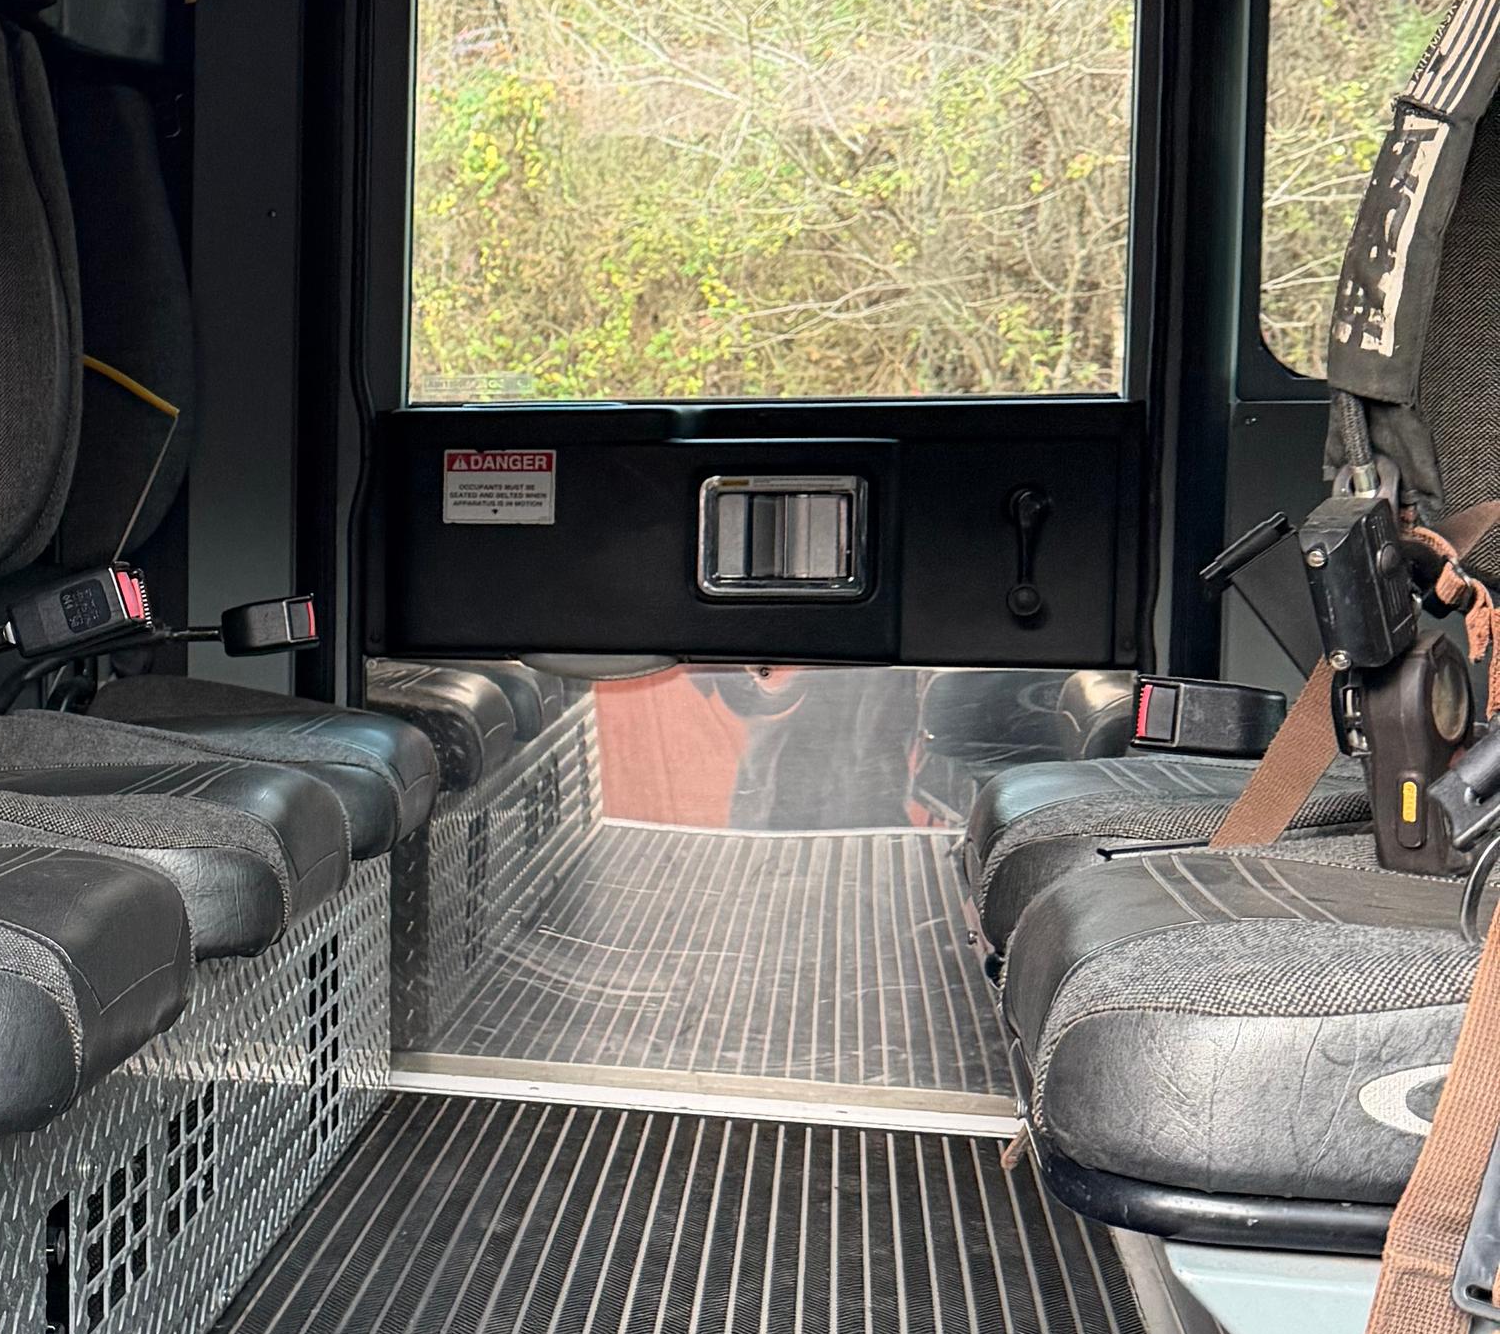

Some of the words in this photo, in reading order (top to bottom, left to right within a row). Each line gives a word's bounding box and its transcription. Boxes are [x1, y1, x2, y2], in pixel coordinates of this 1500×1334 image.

[469, 454, 548, 471] DANGER
[458, 483, 503, 491] OCCUPANTS
[504, 483, 524, 491] MUST
[452, 500, 495, 508] APPARATUS
[515, 500, 543, 508] MOTION
